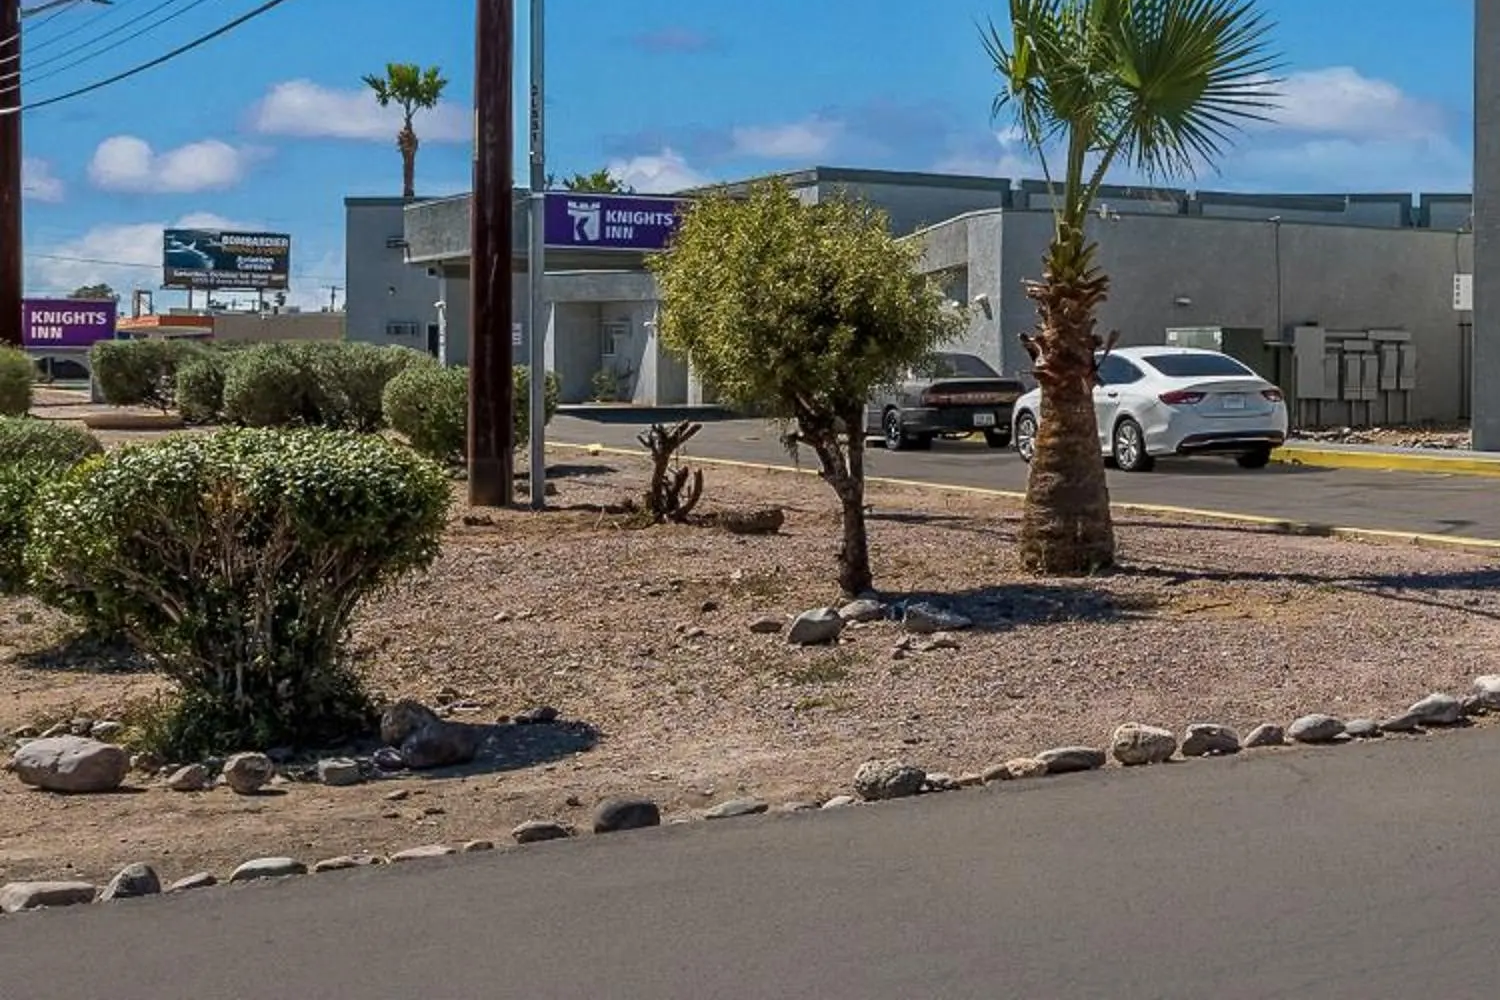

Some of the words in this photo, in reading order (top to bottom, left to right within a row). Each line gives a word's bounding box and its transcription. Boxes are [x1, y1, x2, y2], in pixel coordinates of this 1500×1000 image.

[605, 209, 674, 226] KNIGHTS
[605, 225, 634, 239] INN
[222, 236, 288, 247] BOMBARDIER
[31, 311, 107, 325] KNIGHTS
[31, 326, 63, 339] INN
